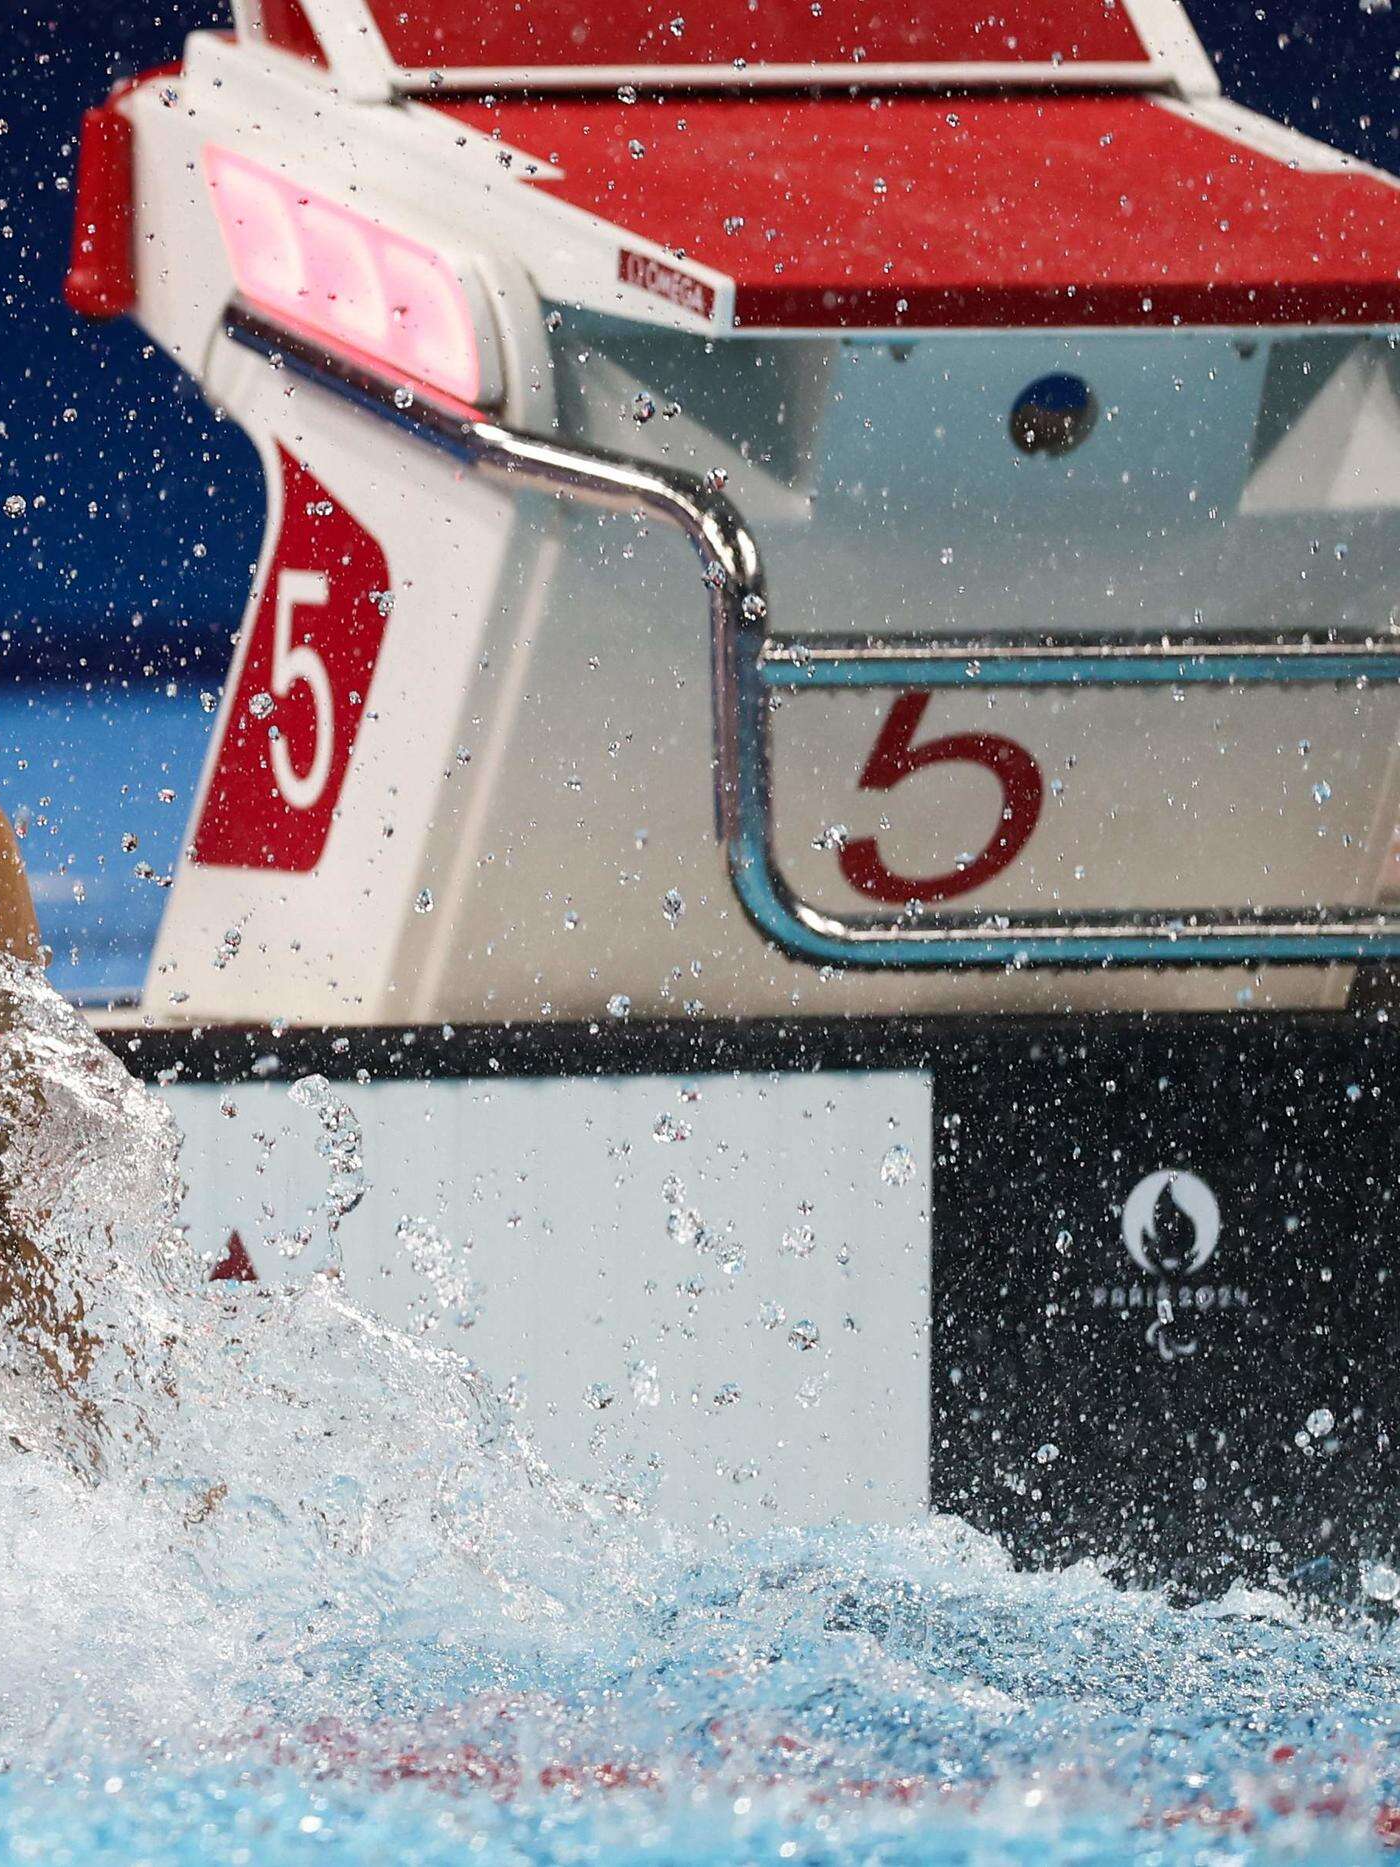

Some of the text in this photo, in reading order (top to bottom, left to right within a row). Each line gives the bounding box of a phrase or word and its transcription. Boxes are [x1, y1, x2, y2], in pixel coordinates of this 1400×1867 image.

[271, 568, 335, 811] 5
[837, 690, 1044, 905] 5
[1178, 1285, 1249, 1309] 2024
